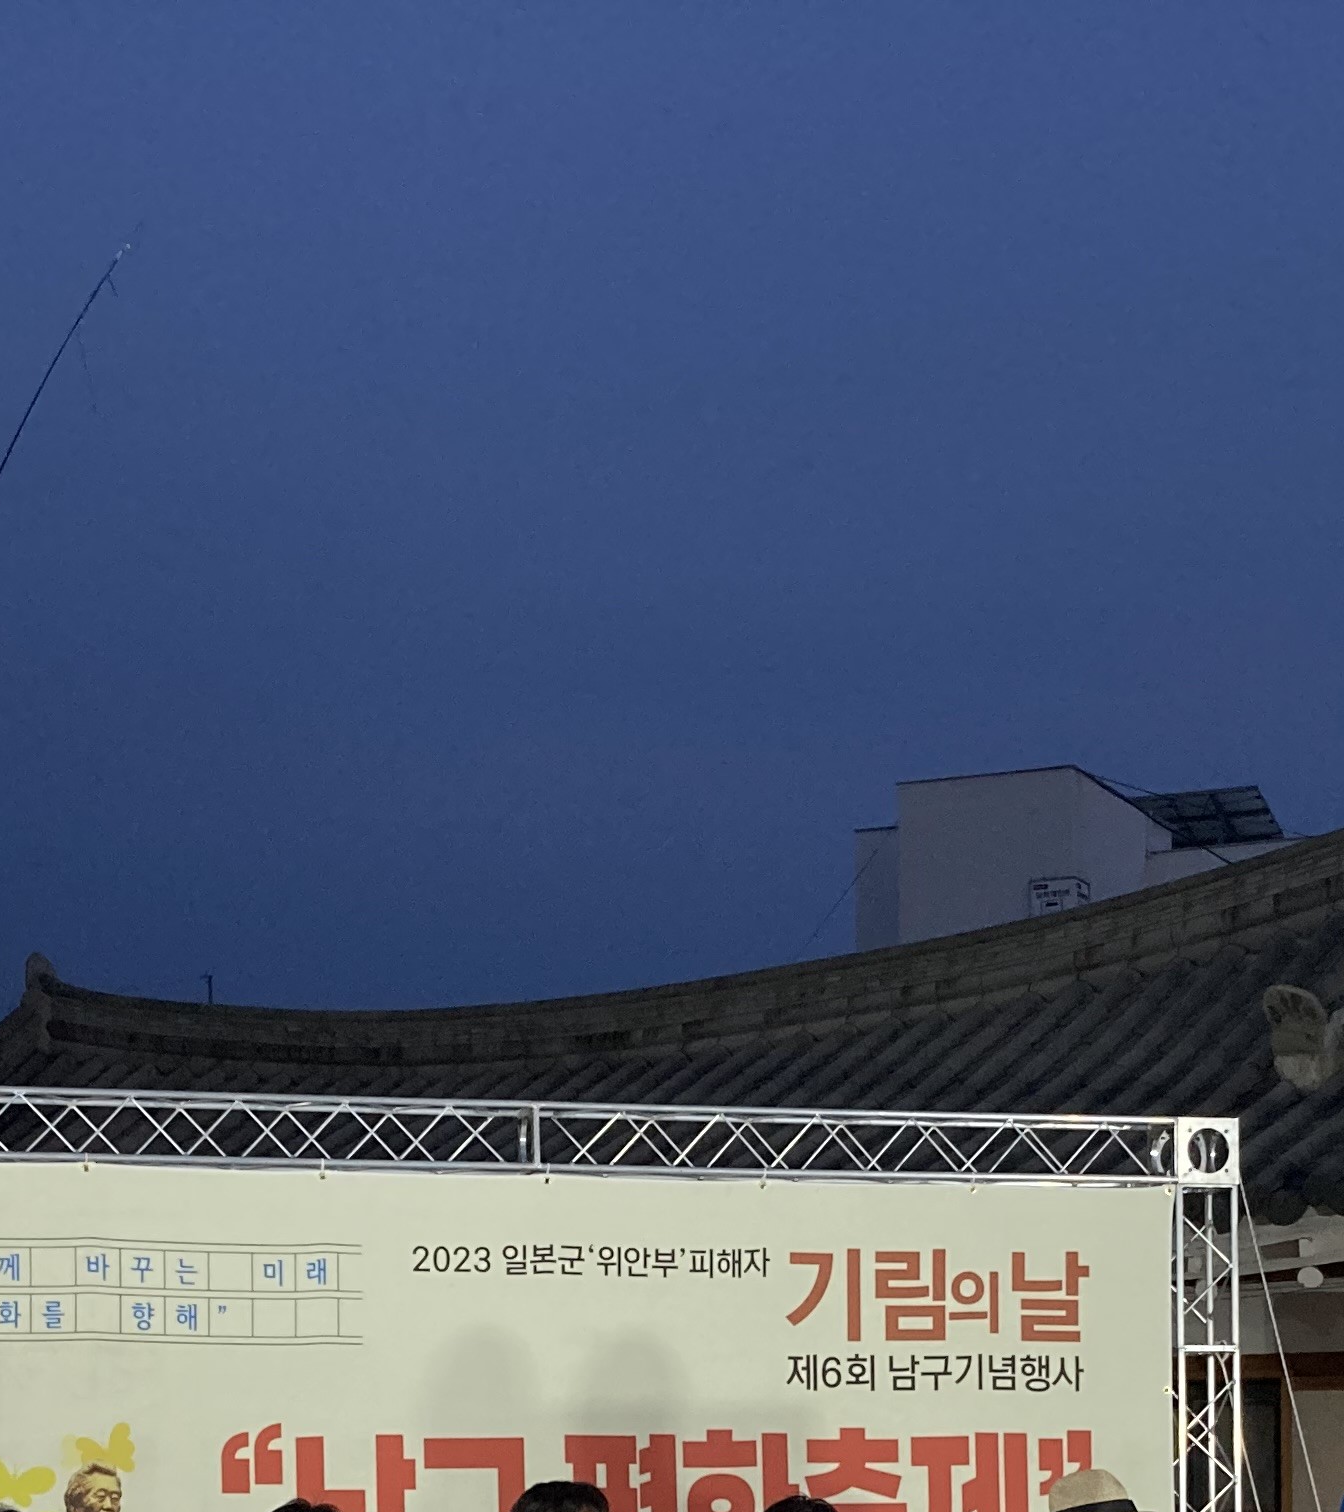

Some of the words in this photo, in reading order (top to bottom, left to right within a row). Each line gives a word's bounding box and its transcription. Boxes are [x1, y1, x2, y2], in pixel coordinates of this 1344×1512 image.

[86, 1252, 199, 1286] 바꾸는
[264, 1257, 328, 1287] 미래
[412, 1246, 492, 1274] 2023
[132, 1302, 226, 1332] 향해”
[786, 1354, 877, 1392] 제6회
[888, 1354, 1084, 1392] 남구기념행사
